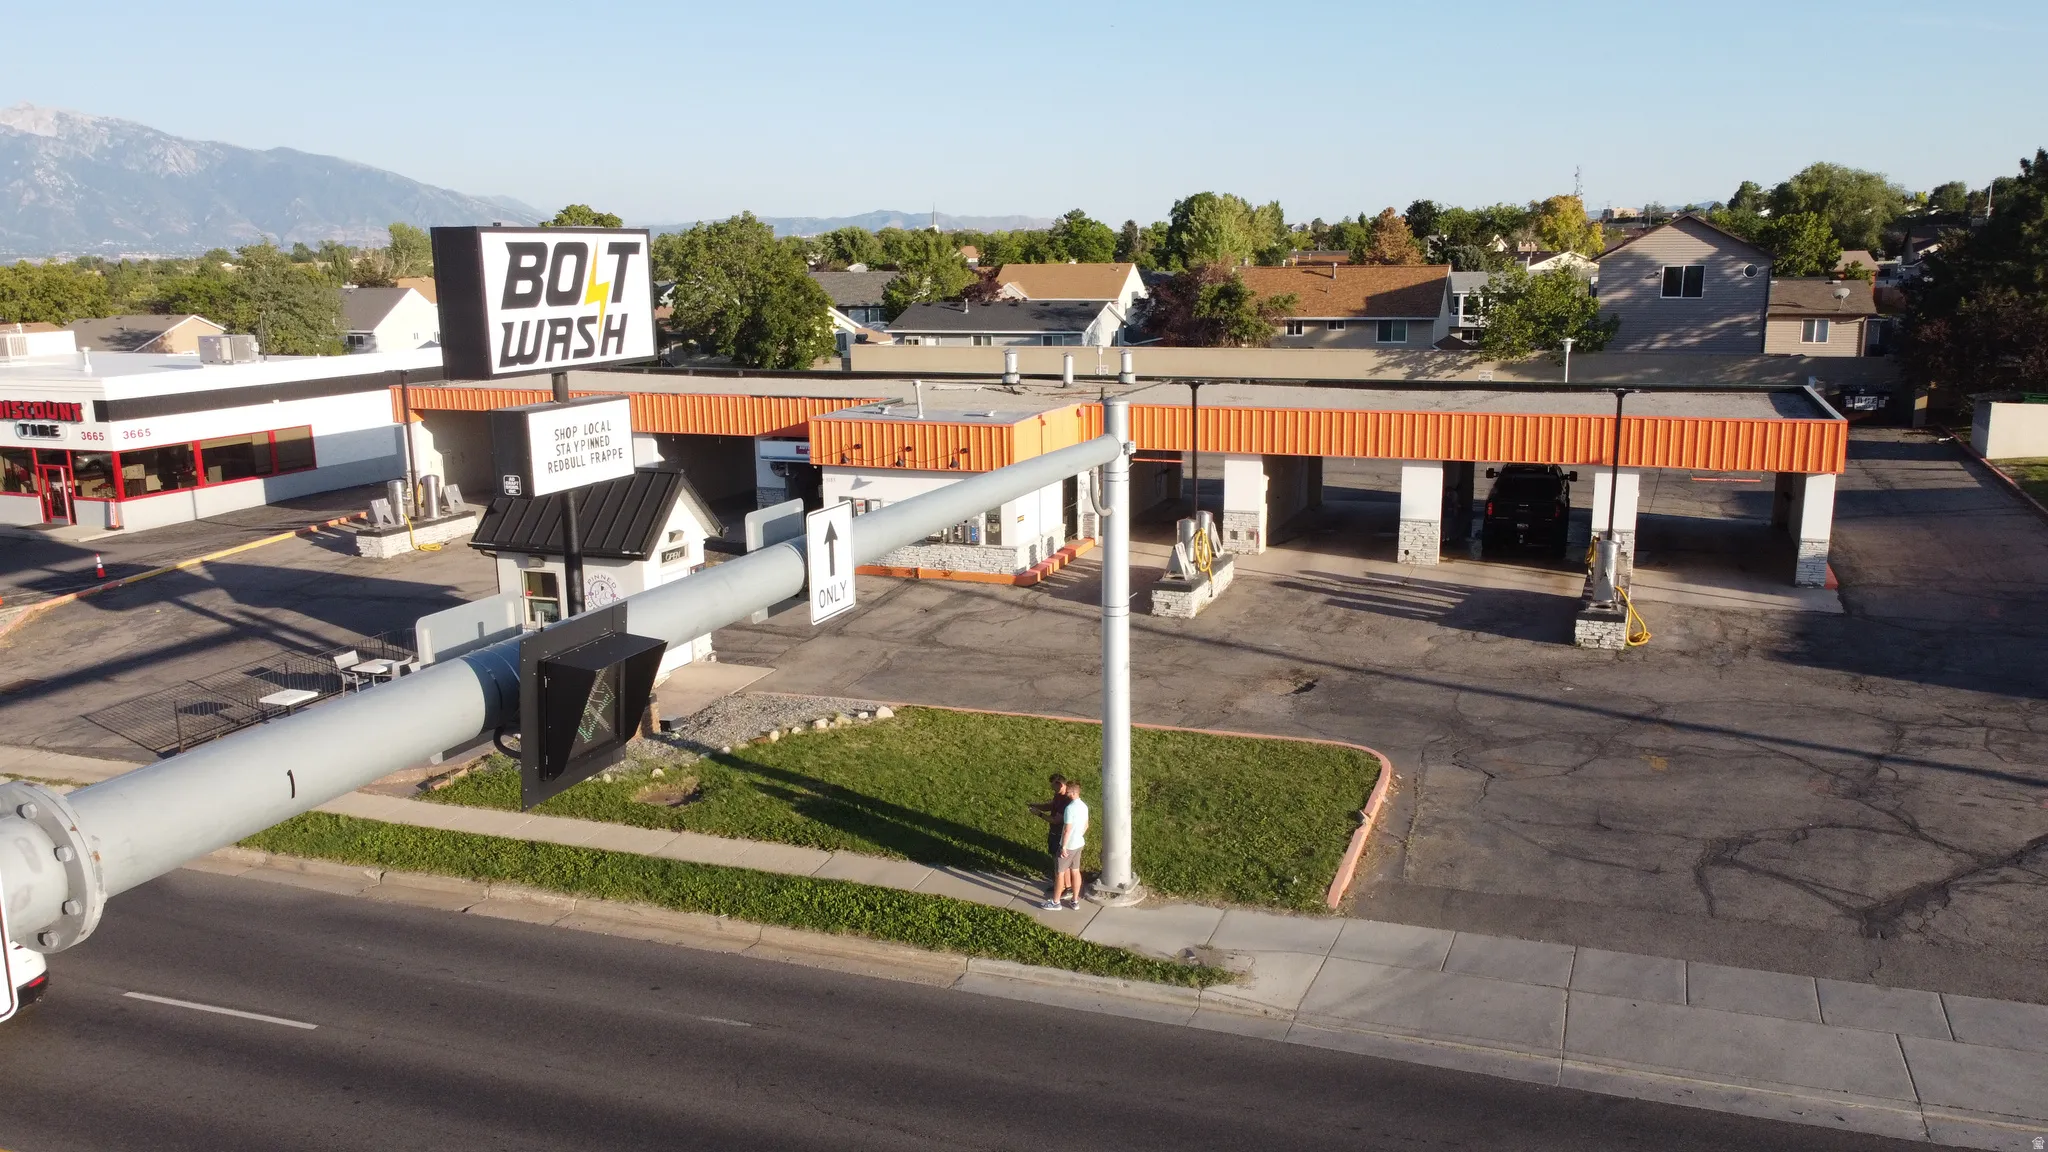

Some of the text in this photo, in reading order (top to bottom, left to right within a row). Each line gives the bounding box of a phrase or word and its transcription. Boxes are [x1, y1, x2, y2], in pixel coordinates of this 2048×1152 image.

[501, 241, 641, 310] BOLT
[499, 313, 629, 368] WASH
[19, 423, 60, 437] TIRE
[81, 431, 104, 441] 3665
[123, 428, 151, 440] 3665
[554, 419, 611, 441] SHOP LOCAL
[548, 447, 623, 474] REDBULL FRAPPE
[665, 550, 681, 561] OPEN
[587, 574, 617, 589] PINNED
[819, 580, 847, 608] ONLY
